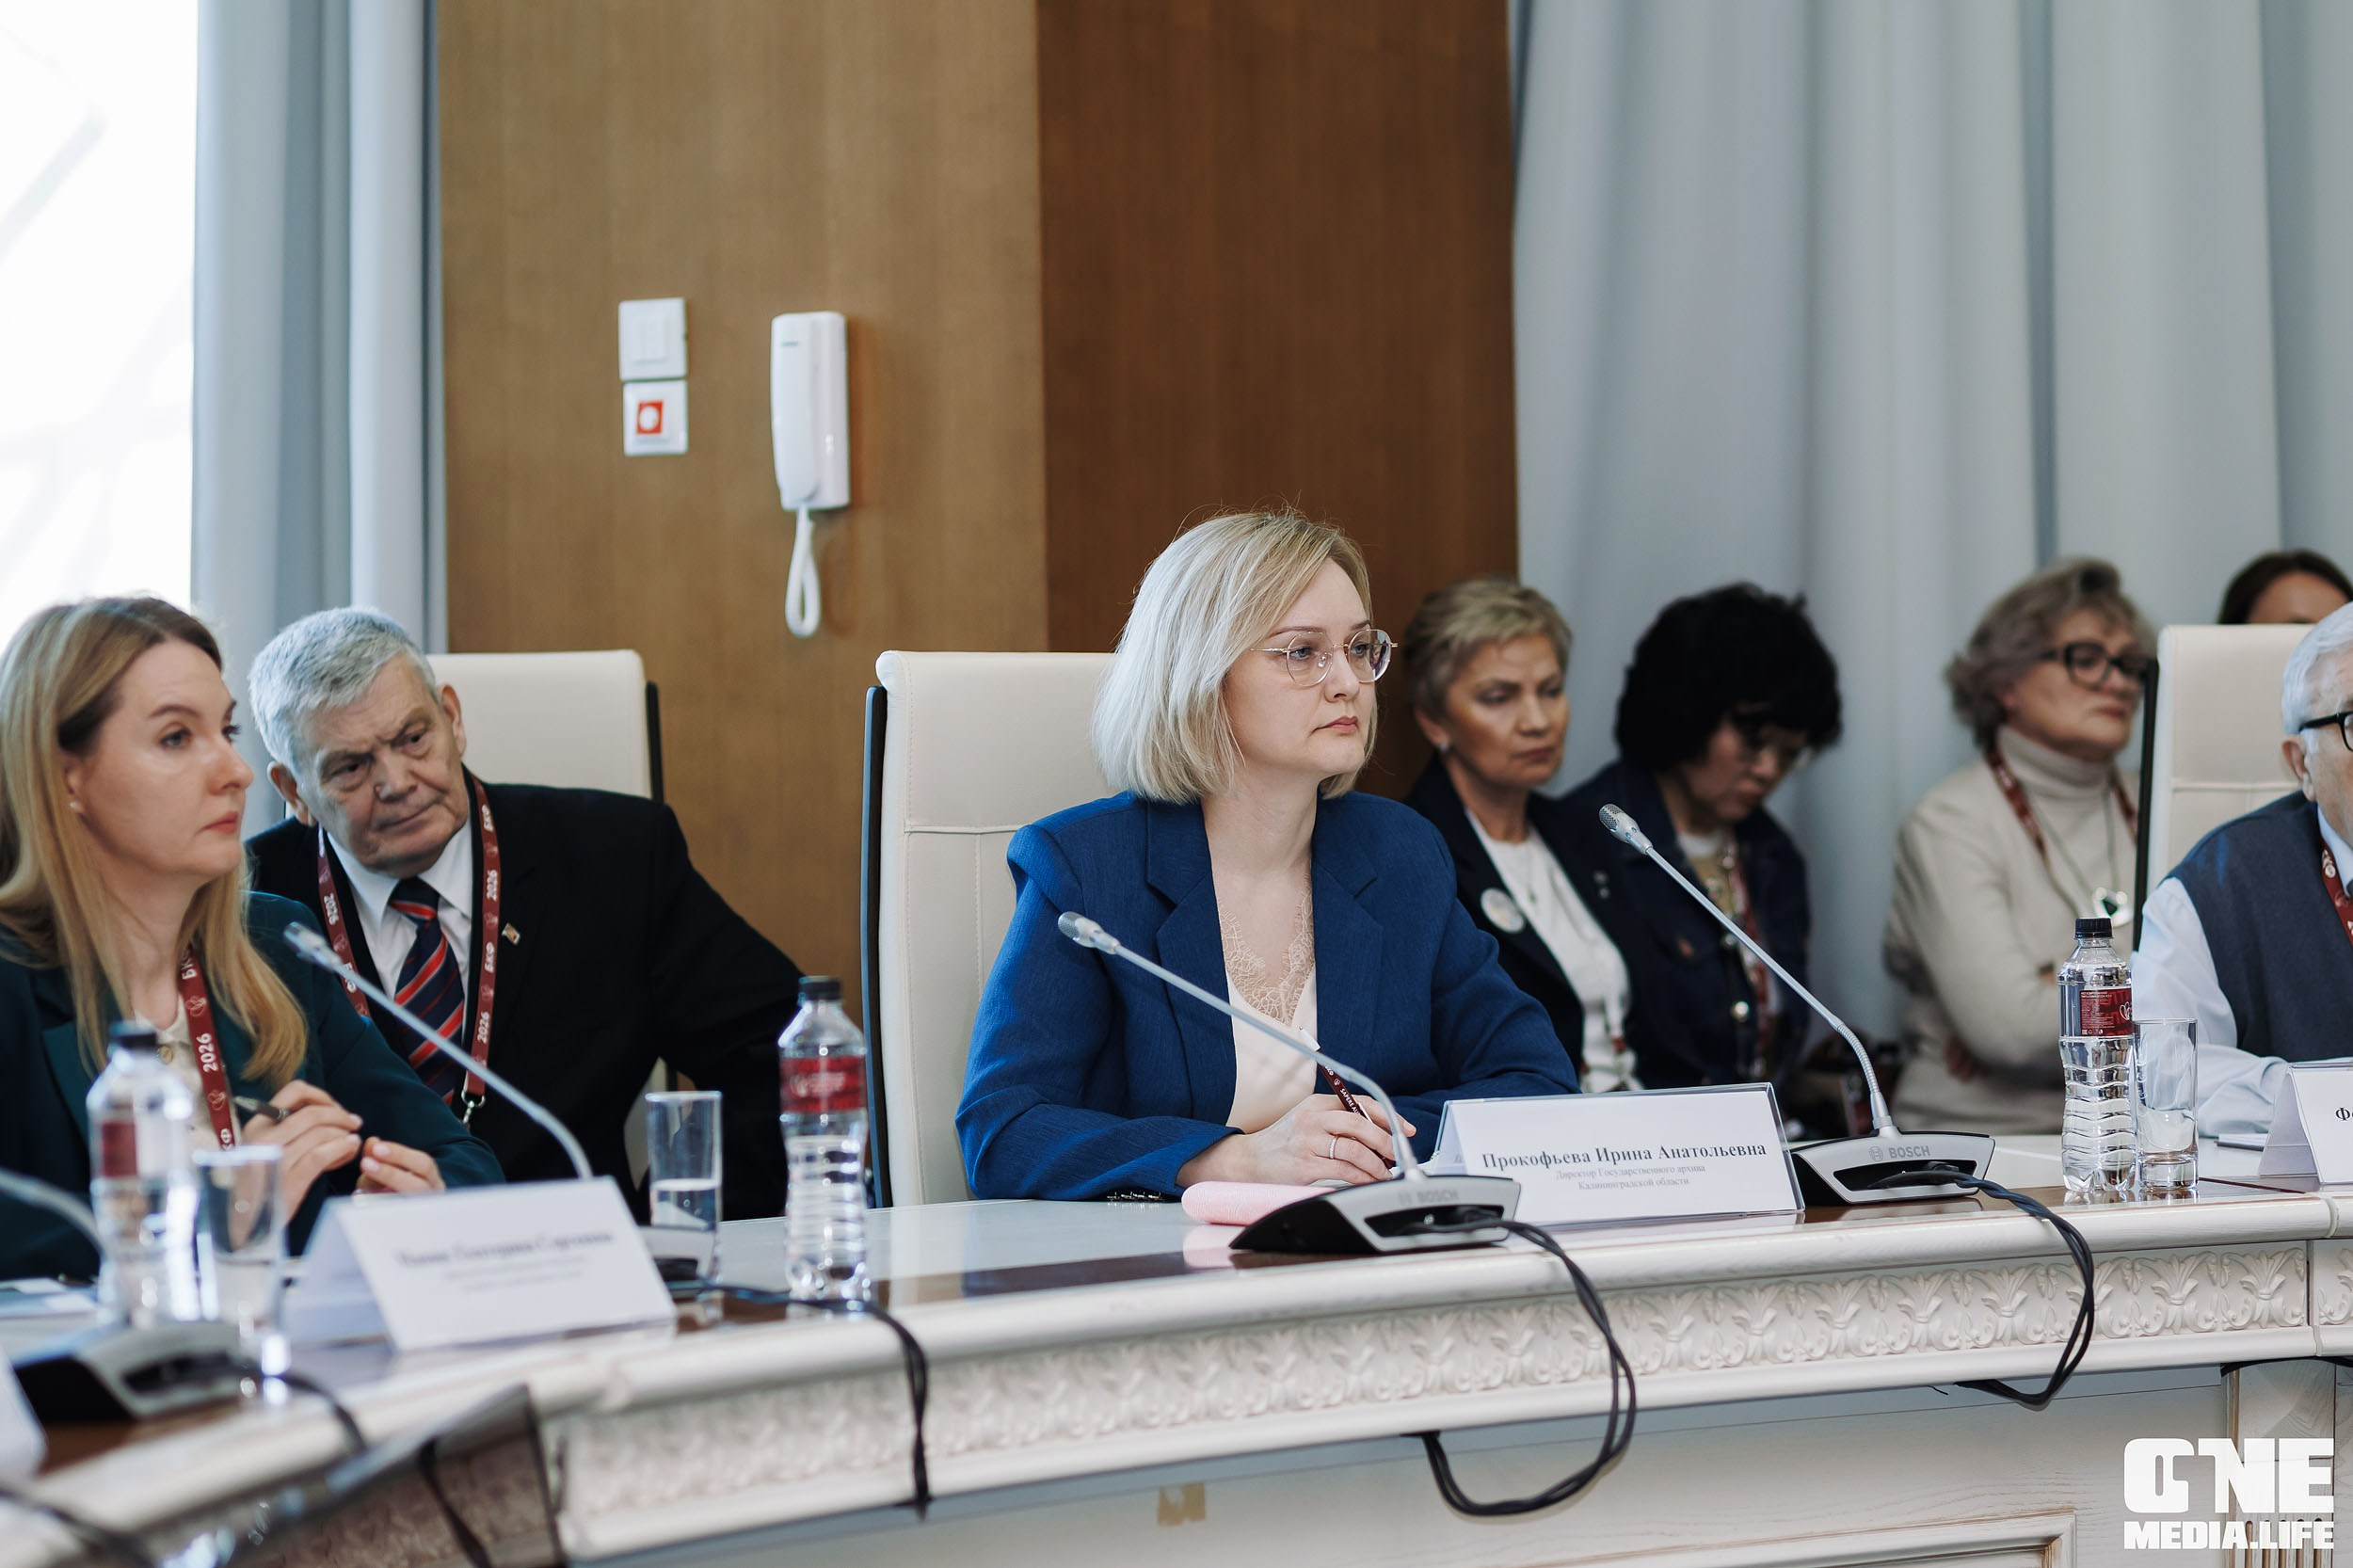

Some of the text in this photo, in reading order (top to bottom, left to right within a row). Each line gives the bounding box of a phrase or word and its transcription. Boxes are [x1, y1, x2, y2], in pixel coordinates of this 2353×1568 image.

[487, 870, 498, 902] 2026
[324, 893, 339, 925] 2026
[485, 942, 494, 973] БКФ
[477, 1011, 489, 1044] 2026
[196, 1032, 218, 1073] 2026
[1482, 1144, 1767, 1171] Прокофьева Ирина Анатольевна
[1888, 1145, 1930, 1159] BOSCH
[1677, 1164, 1705, 1174] архива
